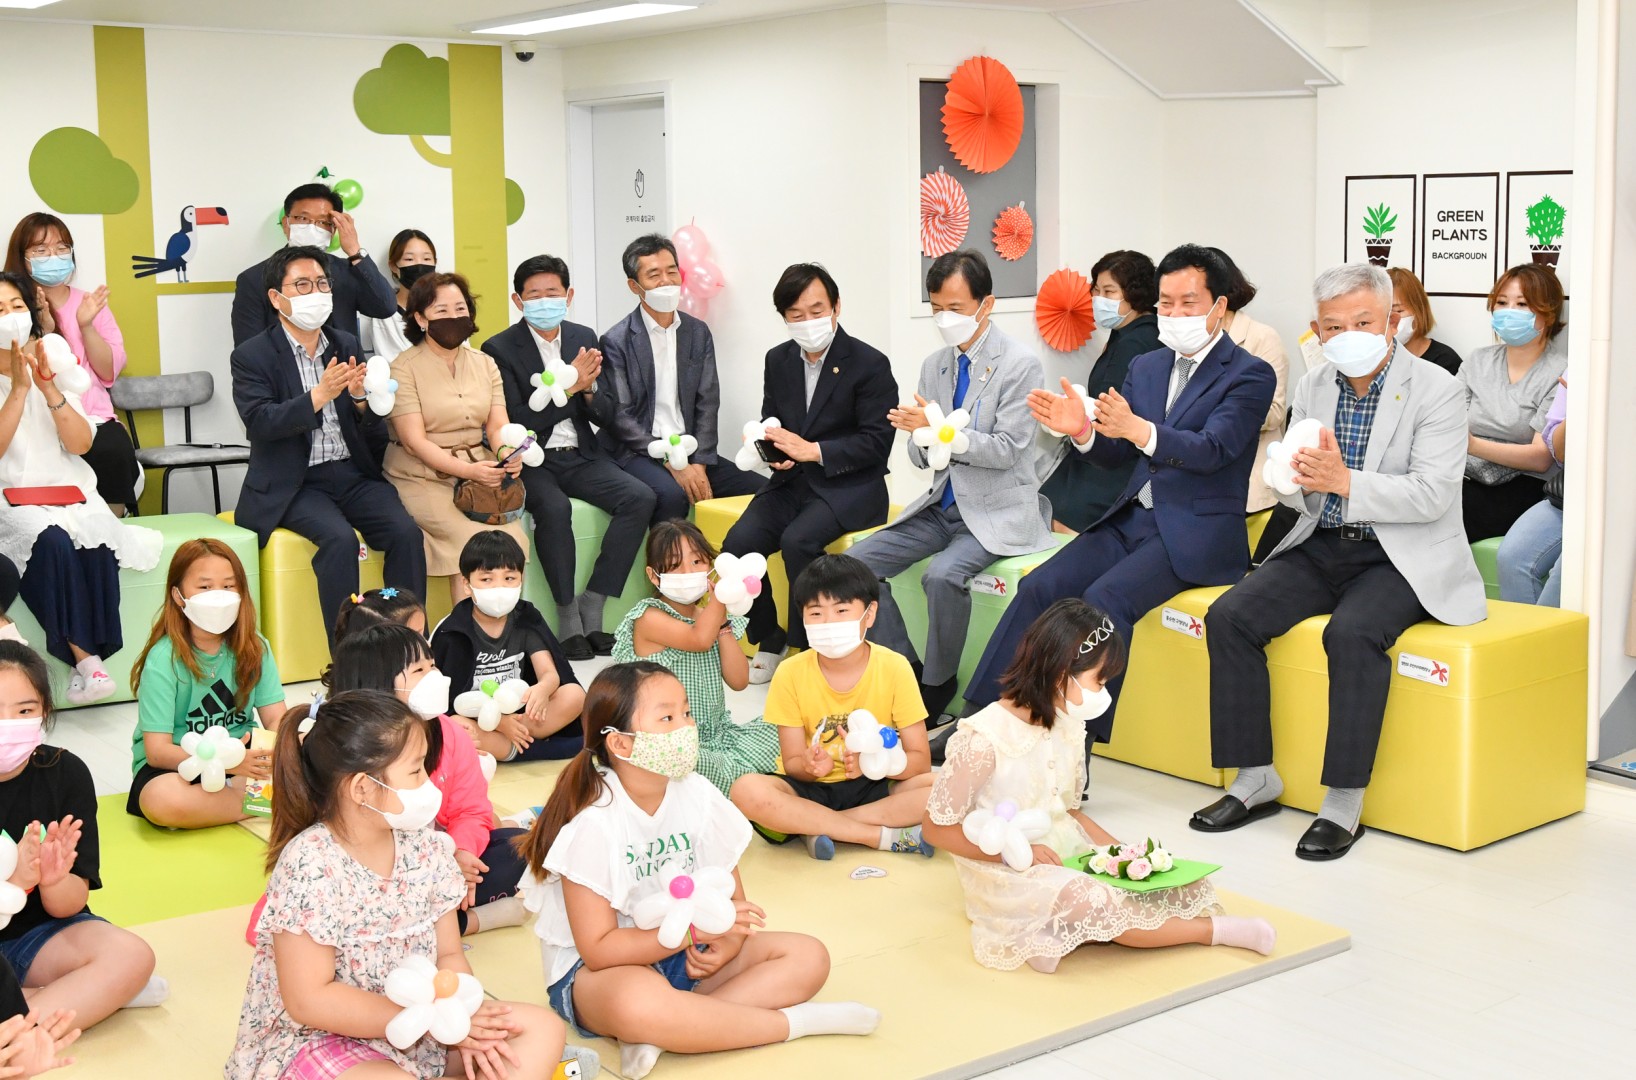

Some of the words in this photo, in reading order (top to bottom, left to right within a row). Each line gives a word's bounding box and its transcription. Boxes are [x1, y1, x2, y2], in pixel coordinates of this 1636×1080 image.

[1437, 210, 1484, 222] GREEN
[1432, 229, 1488, 241] PLANTS
[1432, 252, 1487, 260] BACKGROUDN
